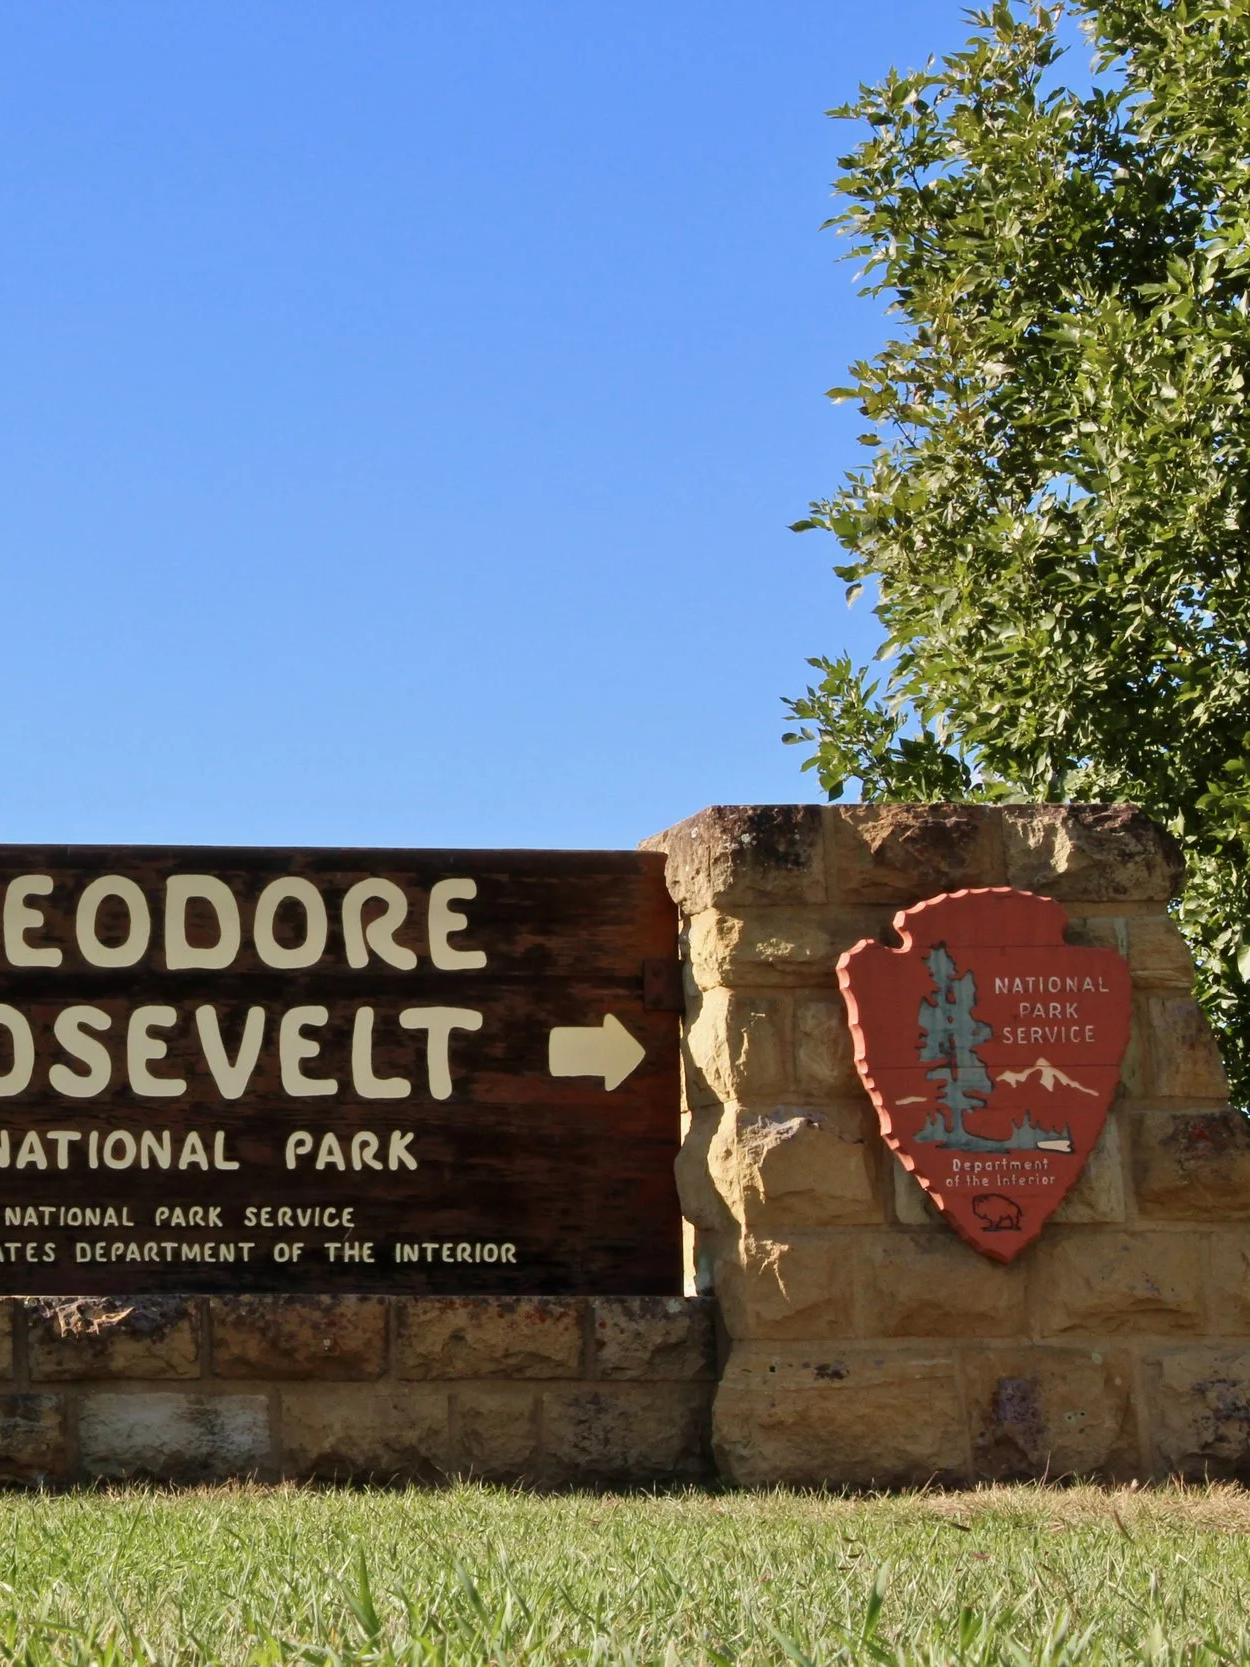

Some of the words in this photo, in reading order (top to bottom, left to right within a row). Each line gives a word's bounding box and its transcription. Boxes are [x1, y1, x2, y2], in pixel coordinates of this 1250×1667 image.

[995, 976, 1109, 995] NATIONAL
[1019, 1002, 1078, 1019] PARK
[1002, 1025, 1095, 1044] SERVICE
[286, 1129, 418, 1171] PARK
[952, 1157, 1049, 1174] Department
[945, 1175, 960, 1187] of
[966, 1175, 989, 1187] the
[997, 1174, 1056, 1187] Interior
[5, 1206, 135, 1228] NATIONAL
[156, 1206, 224, 1228] PARK
[244, 1206, 355, 1228] SERVICE
[76, 1242, 256, 1263] DEPARTMENT
[274, 1242, 305, 1263] OF
[324, 1241, 375, 1263] THE
[396, 1242, 517, 1264] INTERIOR
